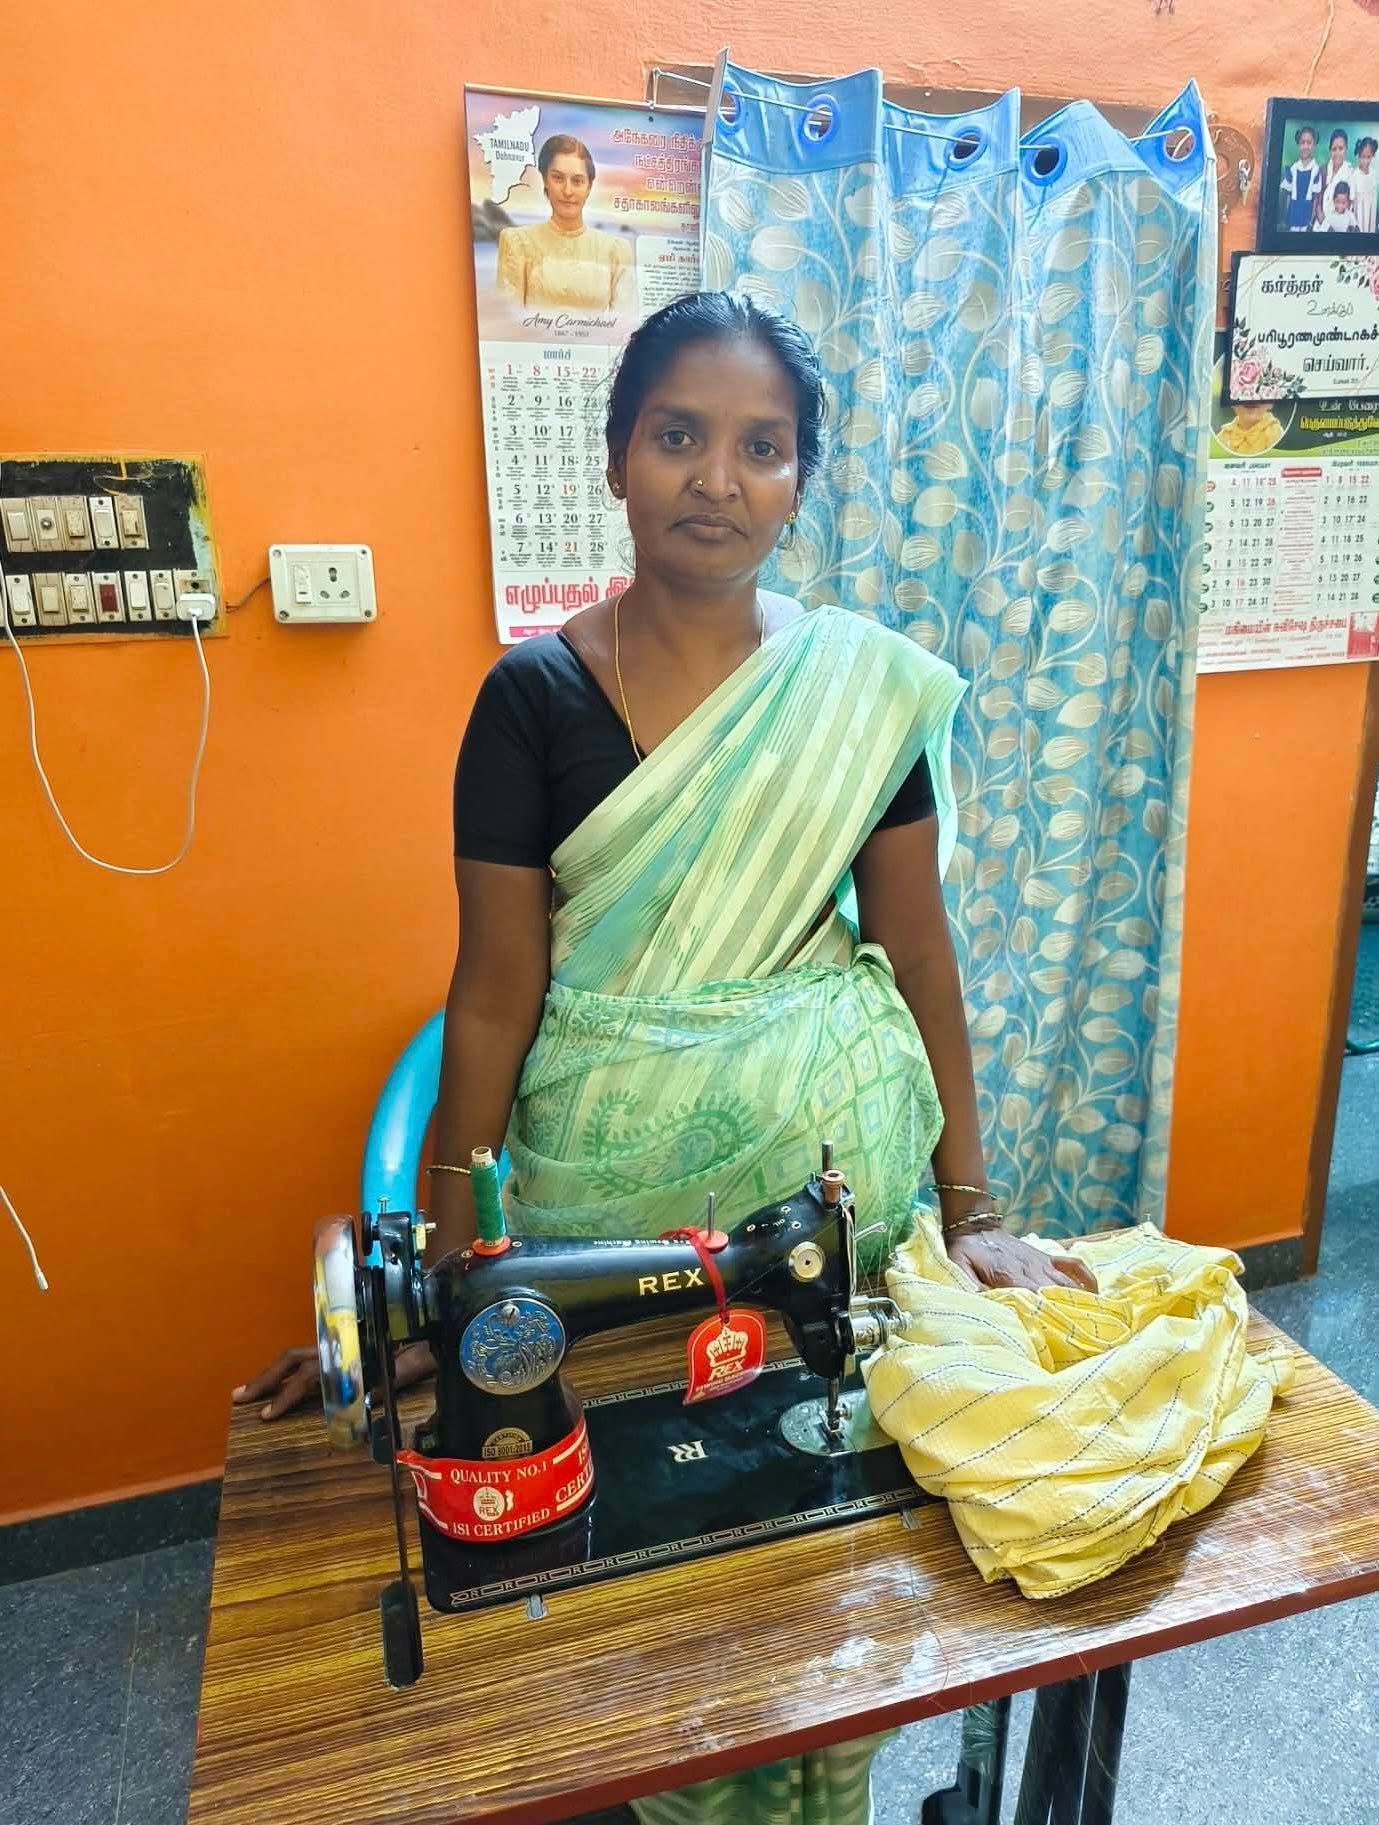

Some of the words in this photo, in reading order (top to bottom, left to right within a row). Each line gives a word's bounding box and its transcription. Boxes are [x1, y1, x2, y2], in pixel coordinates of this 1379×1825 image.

[490, 138, 529, 152] TAMILNADU
[672, 132, 700, 152] நீதிக்
[635, 154, 700, 173] நட்சத்திரங்க
[647, 176, 700, 194] என்றென்
[1261, 274, 1324, 298] கர்த்தர்
[522, 312, 553, 329] Amy
[556, 313, 618, 329] Carmichael
[507, 364, 512, 375] 1
[533, 366, 541, 376] 8
[557, 366, 571, 377] 15
[582, 367, 597, 378] 22
[1303, 354, 1369, 372] செய்வார்.
[508, 395, 515, 406] 2
[535, 396, 542, 406] 9
[559, 396, 572, 407] 16
[510, 425, 517, 436] 3
[534, 425, 548, 436] 10
[560, 426, 574, 437] 17
[512, 455, 518, 465] 4
[535, 456, 548, 466] 11
[562, 456, 575, 466] 18
[586, 456, 600, 466] 25
[513, 485, 520, 495] 5
[537, 484, 550, 495] 12
[563, 485, 577, 495] 19
[587, 485, 602, 496] 26
[516, 514, 523, 524] 6
[539, 514, 552, 524] 13
[563, 514, 578, 524] 20
[589, 514, 603, 524] 27
[517, 542, 525, 552] 7
[540, 543, 553, 552] 14
[565, 542, 578, 552] 21
[590, 542, 605, 552] 28
[506, 577, 599, 614] எழுப்புதல்
[638, 1268, 704, 1296] REX
[708, 1358, 745, 1382] REX
[484, 1447, 496, 1457] ISO
[451, 1469, 512, 1485] QUALITY
[517, 1462, 547, 1479] NO.1
[479, 1506, 500, 1517] REX
[453, 1522, 470, 1536] ISI
[474, 1508, 550, 1538] CERTIFIED
